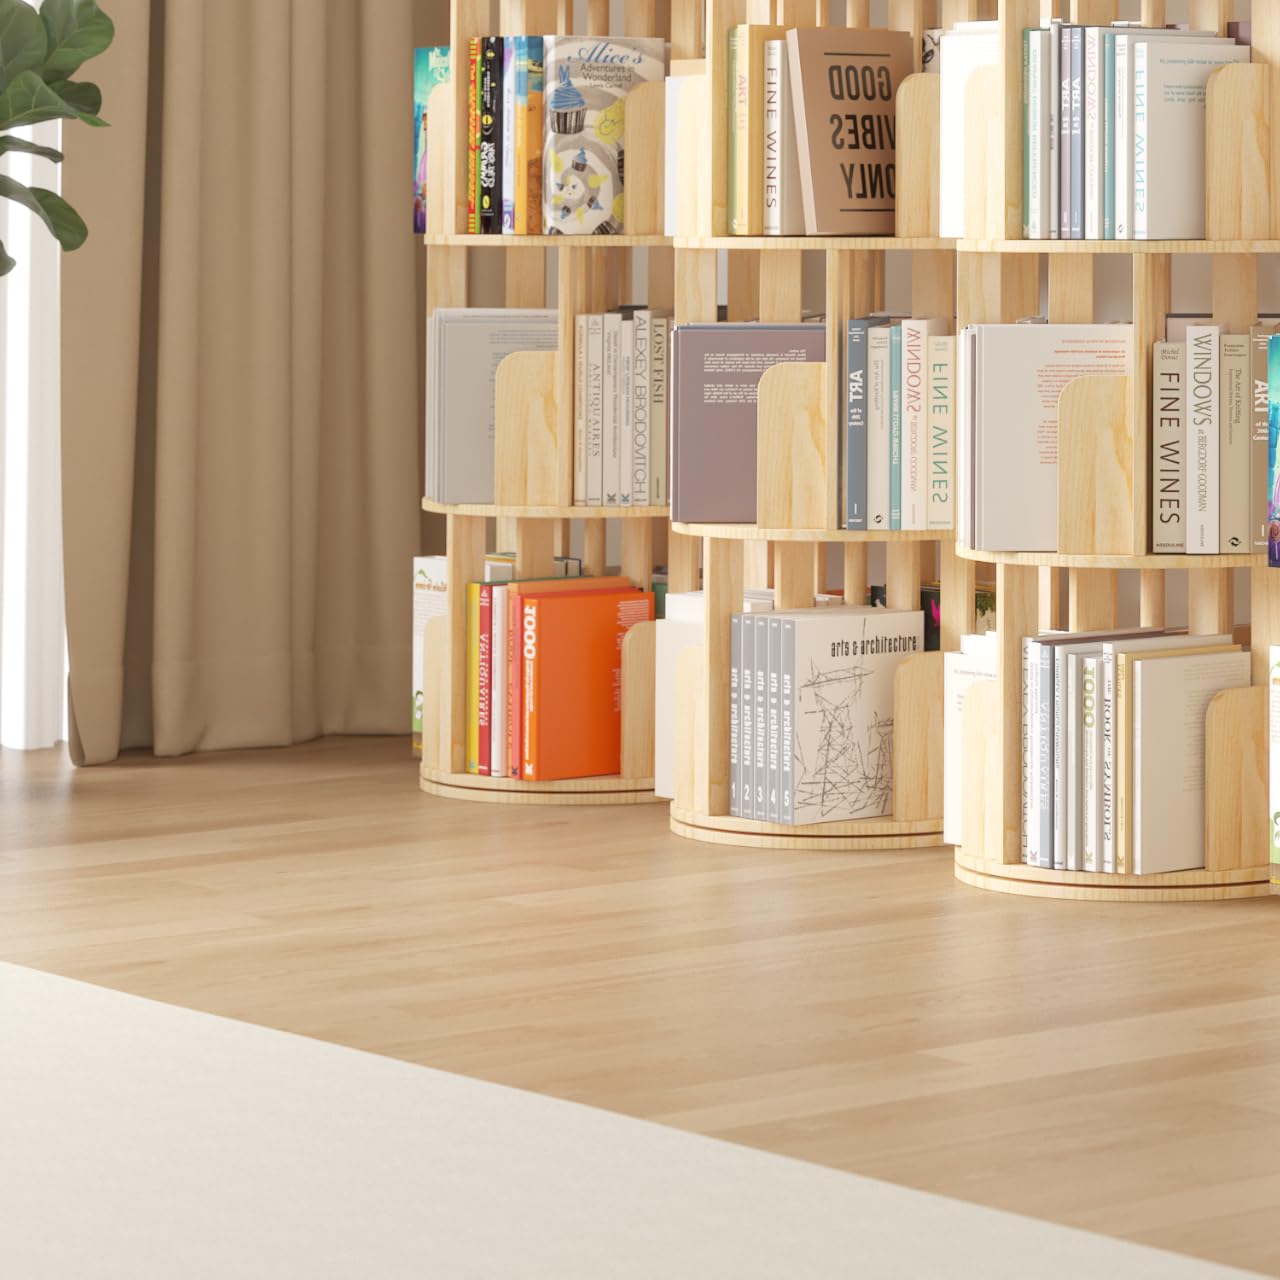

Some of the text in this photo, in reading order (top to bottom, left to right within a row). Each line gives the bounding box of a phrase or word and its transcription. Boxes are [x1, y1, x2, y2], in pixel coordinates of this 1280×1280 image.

[568, 41, 643, 65] Alice's
[581, 64, 625, 73] Adventures
[583, 72, 632, 81] Wonderland
[766, 67, 777, 208] FINE WINES
[654, 324, 664, 404] LOST FISH
[1234, 369, 1242, 380] The
[592, 364, 600, 456] ANTIQUAIRES
[635, 316, 647, 493] ALEXEY BRODOVITCH
[1234, 399, 1242, 424] Knitting
[1194, 333, 1212, 511] WINDOWS BERGDORF GOODMAN
[1160, 373, 1180, 524] FINE WINES
[831, 635, 917, 658] arts & architecture
[770, 672, 778, 692] arts
[770, 709, 778, 770] architecture
[730, 782, 737, 798] 1
[743, 785, 750, 800] 2
[756, 787, 764, 802] 3
[770, 788, 776, 804] 4
[783, 790, 790, 806] 5
